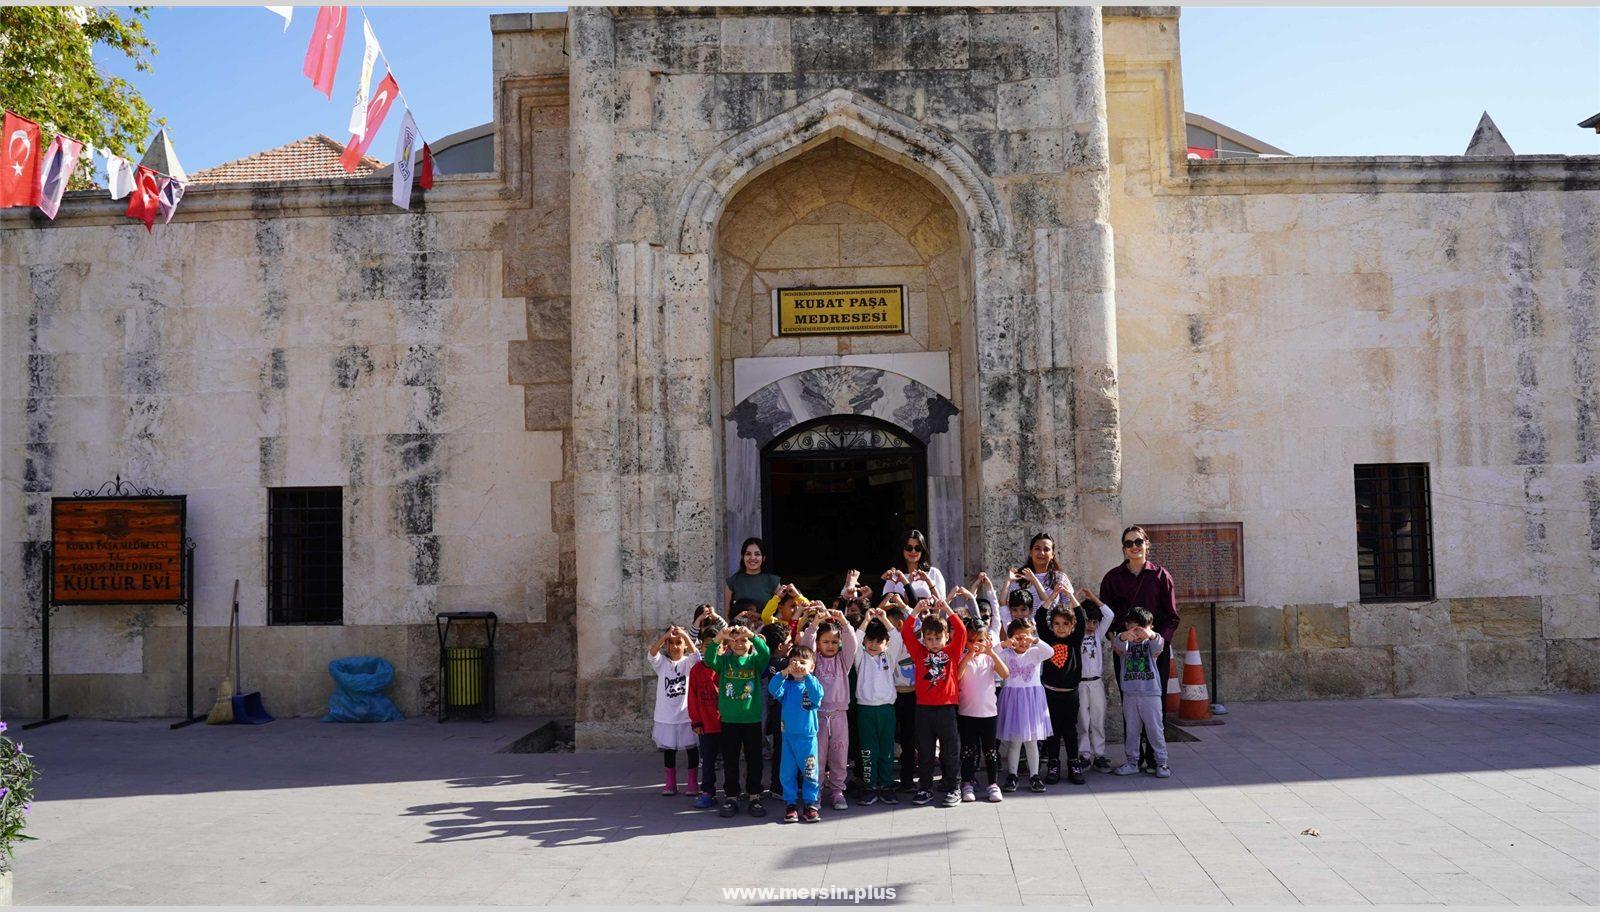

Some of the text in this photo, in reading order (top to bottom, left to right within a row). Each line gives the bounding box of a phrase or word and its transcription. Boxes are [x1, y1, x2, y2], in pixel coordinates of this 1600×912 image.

[794, 297, 887, 309] KUBAT PAŞA
[794, 310, 887, 324] MEDRESESİ
[63, 572, 171, 591] KÜLTÜR EVİ
